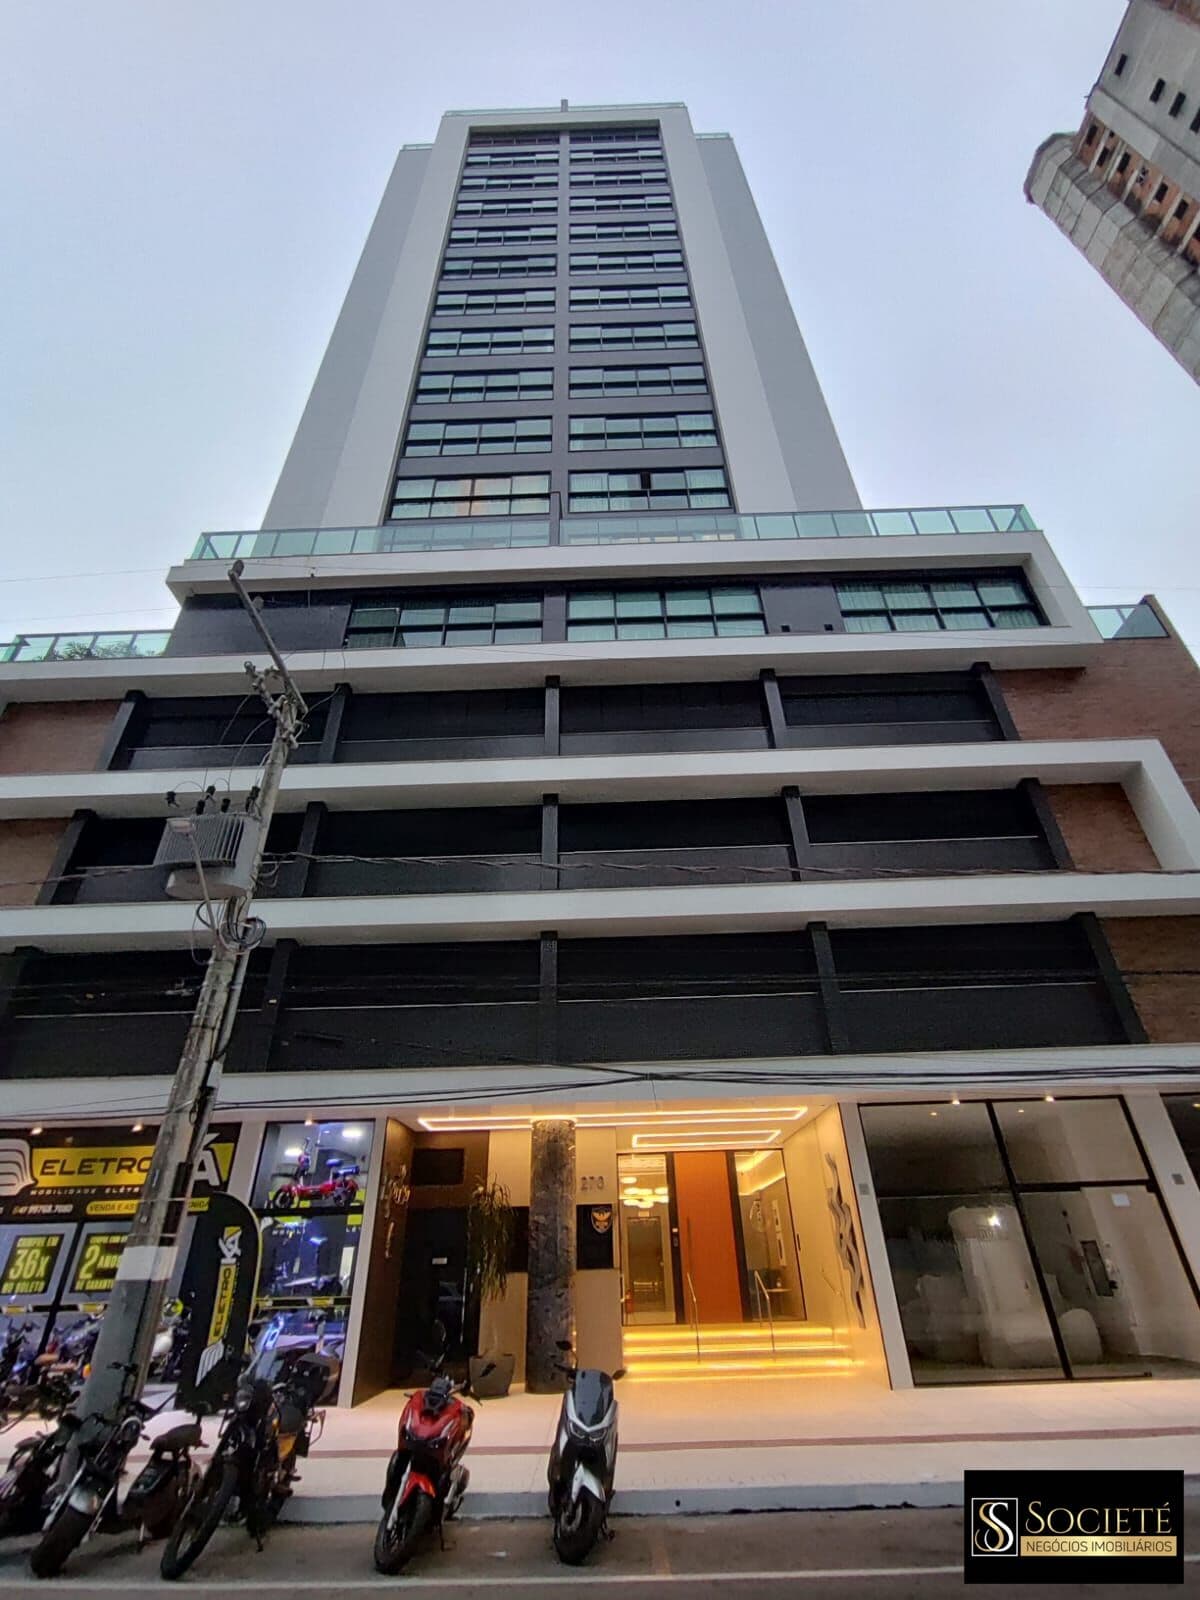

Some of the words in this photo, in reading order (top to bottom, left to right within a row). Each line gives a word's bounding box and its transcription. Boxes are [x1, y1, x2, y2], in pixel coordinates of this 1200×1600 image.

[40, 1156, 152, 1176] ELETRO
[104, 1185, 141, 1194] ELÉTR
[79, 1244, 100, 1279] 2
